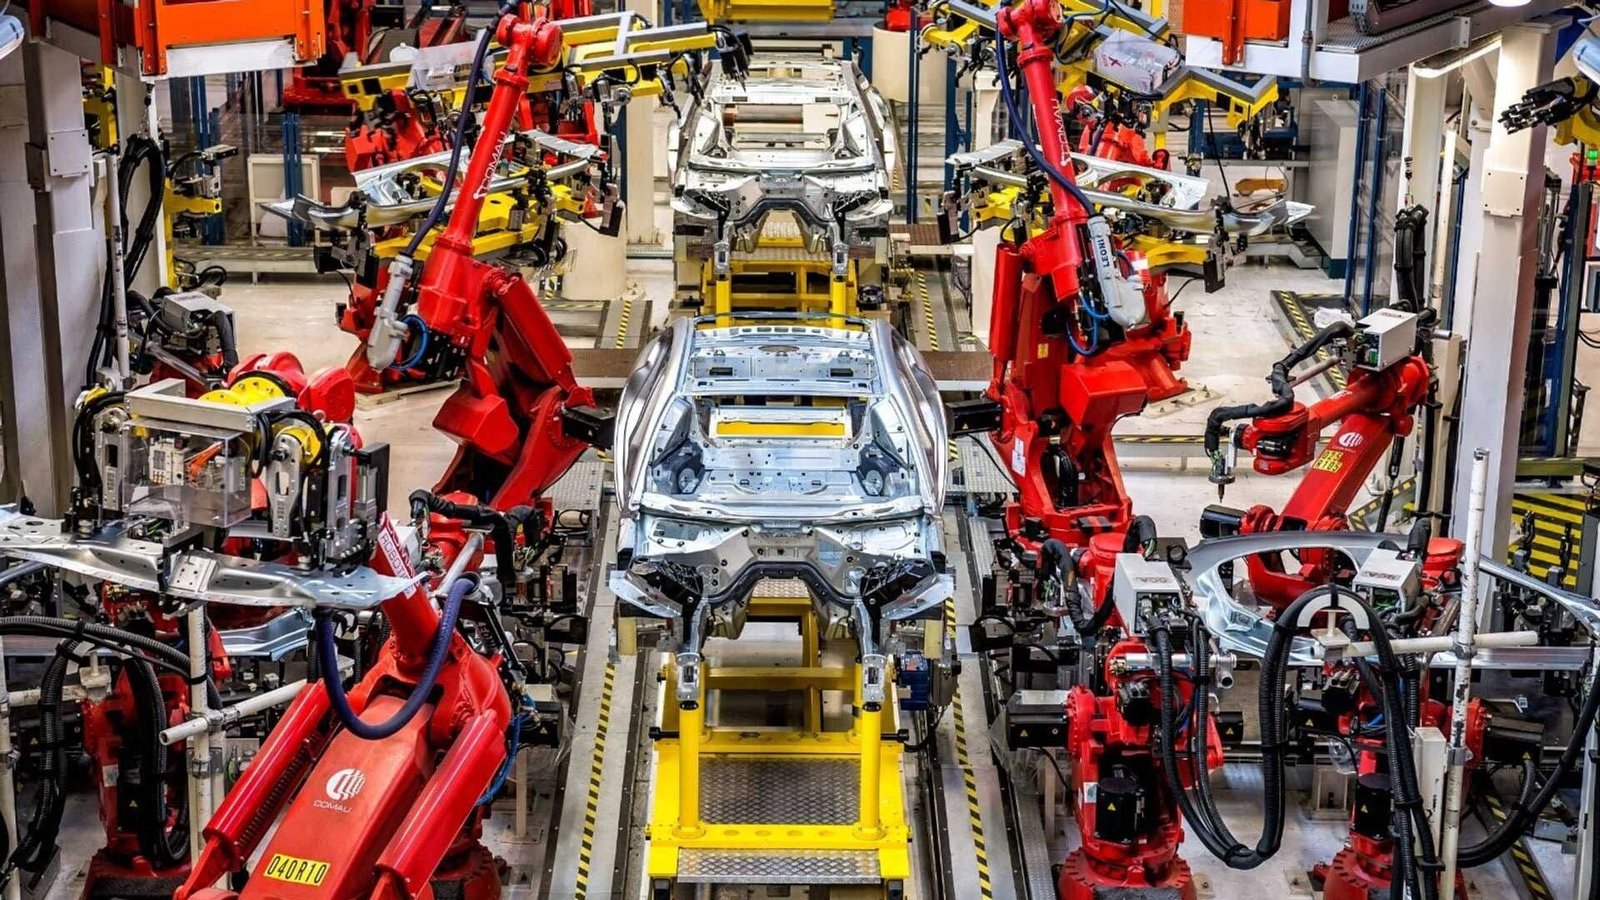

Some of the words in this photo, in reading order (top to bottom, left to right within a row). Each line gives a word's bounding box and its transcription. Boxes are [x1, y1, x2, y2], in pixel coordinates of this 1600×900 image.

[1050, 98, 1071, 155] COMAU
[1096, 239, 1110, 268] LEONI
[313, 800, 353, 813] COMAU
[267, 855, 328, 884] 040R10
